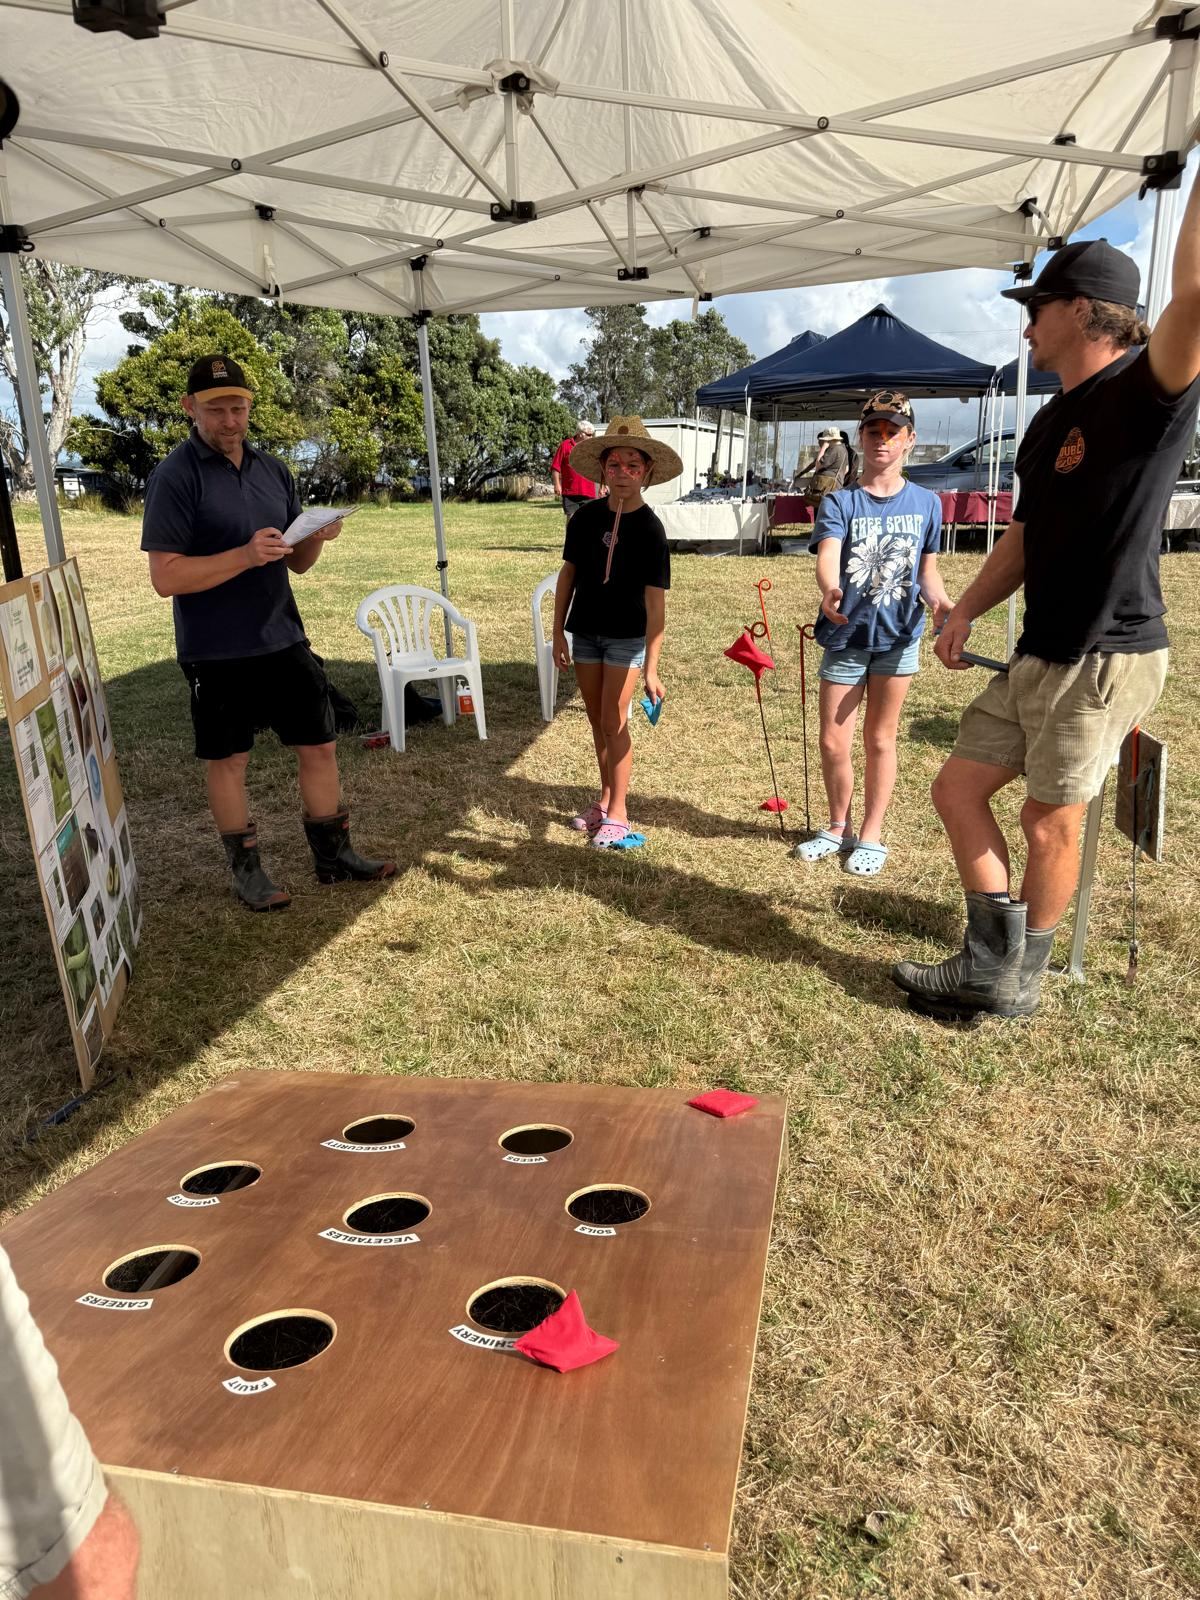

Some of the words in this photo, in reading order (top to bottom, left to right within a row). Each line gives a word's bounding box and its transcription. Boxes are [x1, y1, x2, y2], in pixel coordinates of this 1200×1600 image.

[851, 516, 883, 543] FREE
[886, 514, 924, 539] SPIRIT
[326, 1140, 401, 1151] BIOSECURITY
[171, 1195, 217, 1206] INSECTS
[579, 1226, 613, 1235] SOILS
[325, 1230, 414, 1244] VEGETABLES
[82, 1295, 149, 1308] CAREERS
[452, 1327, 516, 1348] CHINERY
[227, 1380, 269, 1392] FRUIT
